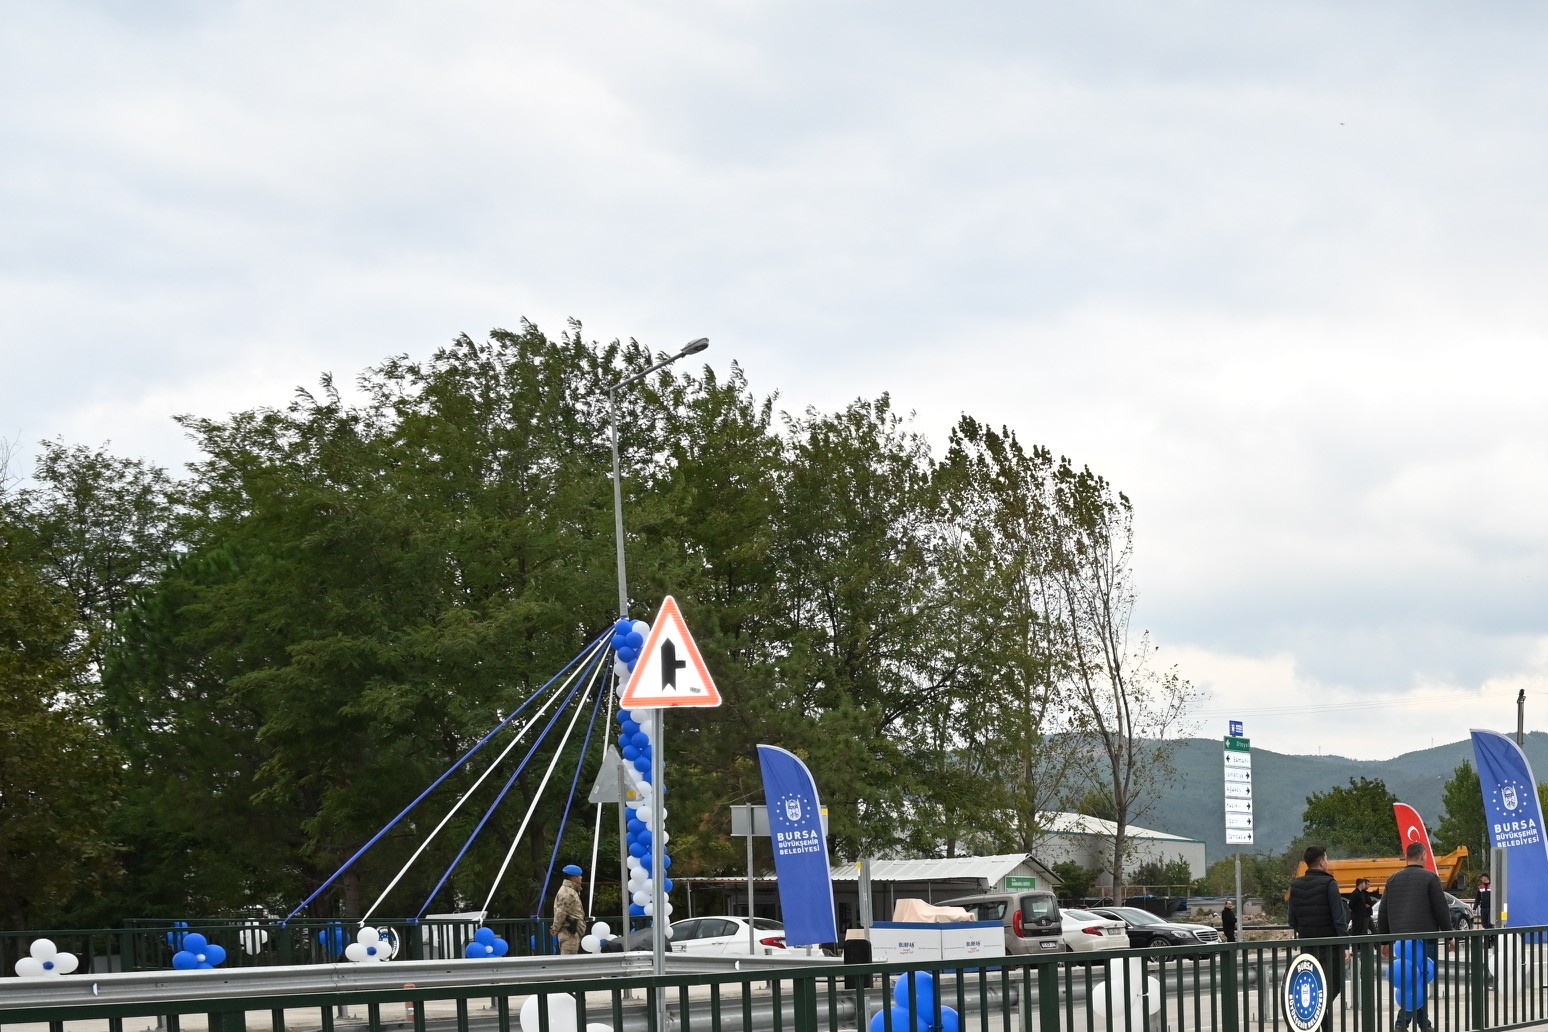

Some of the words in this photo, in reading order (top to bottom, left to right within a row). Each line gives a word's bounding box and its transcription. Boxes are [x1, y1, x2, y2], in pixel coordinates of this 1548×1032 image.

[1494, 818, 1536, 833] BURSA
[777, 829, 818, 841] BURSA
[1496, 828, 1538, 841] BÜYÜKŞEHİR
[778, 837, 819, 849] BÜYÜKŞEHİR
[1497, 835, 1540, 848] BELEDİYESİ
[779, 844, 820, 855] BELEDİYESİ
